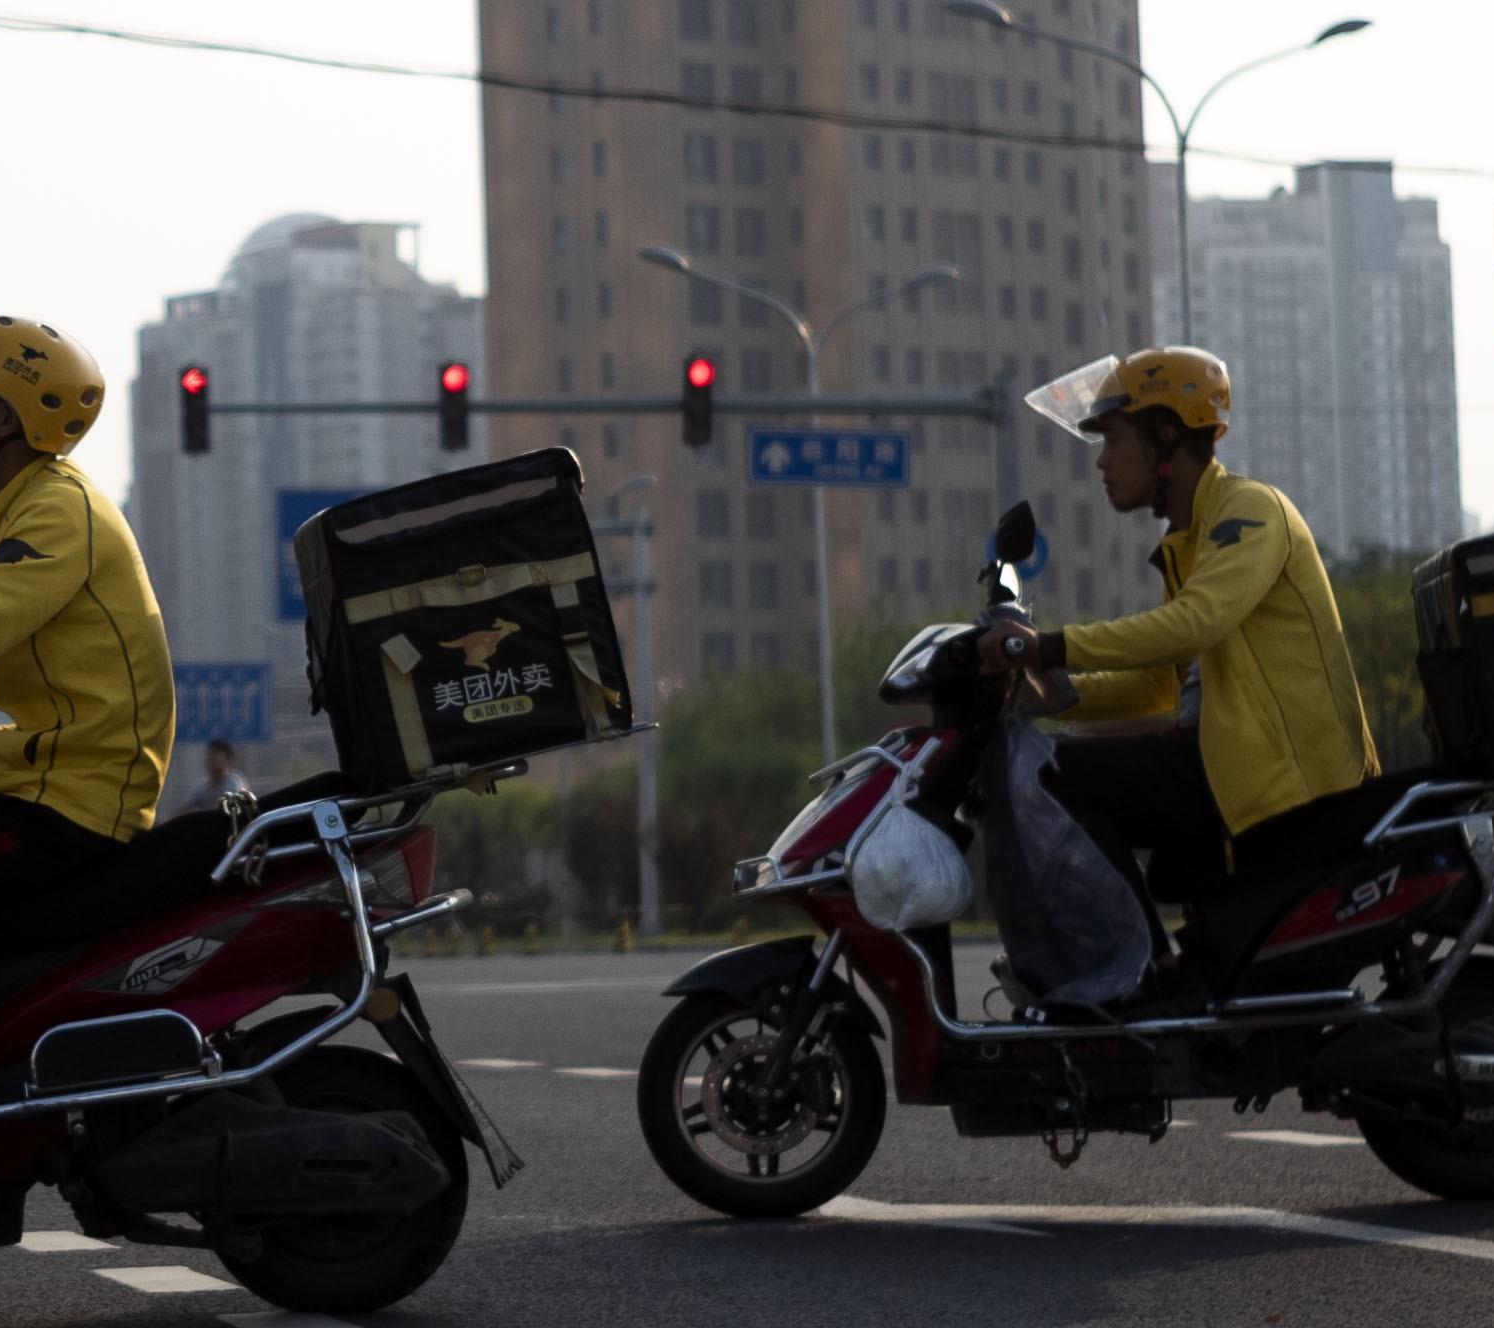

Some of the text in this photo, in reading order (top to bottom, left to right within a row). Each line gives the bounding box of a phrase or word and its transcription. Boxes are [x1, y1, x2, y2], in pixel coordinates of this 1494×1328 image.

[432, 662, 554, 711] 美团外卖
[472, 697, 527, 720] 美团专送
